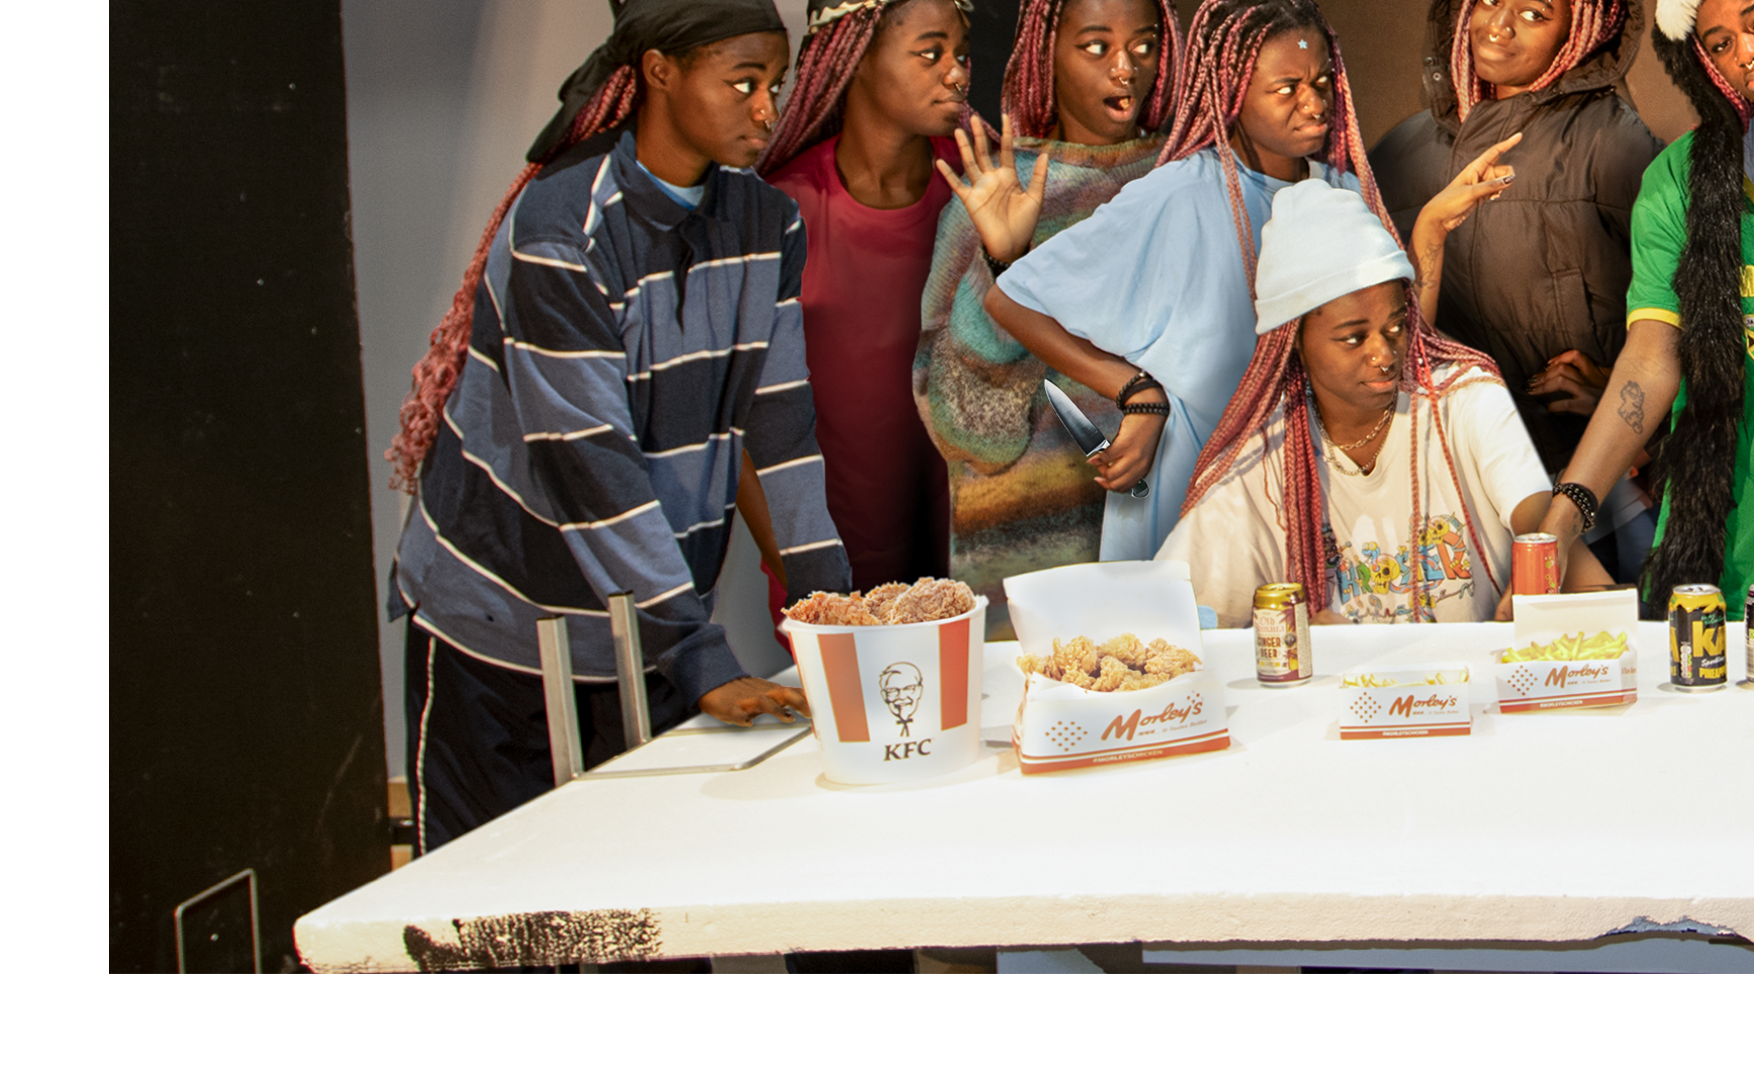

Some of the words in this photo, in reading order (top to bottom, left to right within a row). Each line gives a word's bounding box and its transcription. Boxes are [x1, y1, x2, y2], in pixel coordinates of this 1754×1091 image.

[1544, 663, 1609, 689] Morley's
[1388, 694, 1457, 718] Morley's
[1101, 700, 1203, 741] Morley's
[883, 738, 931, 762] KFC
